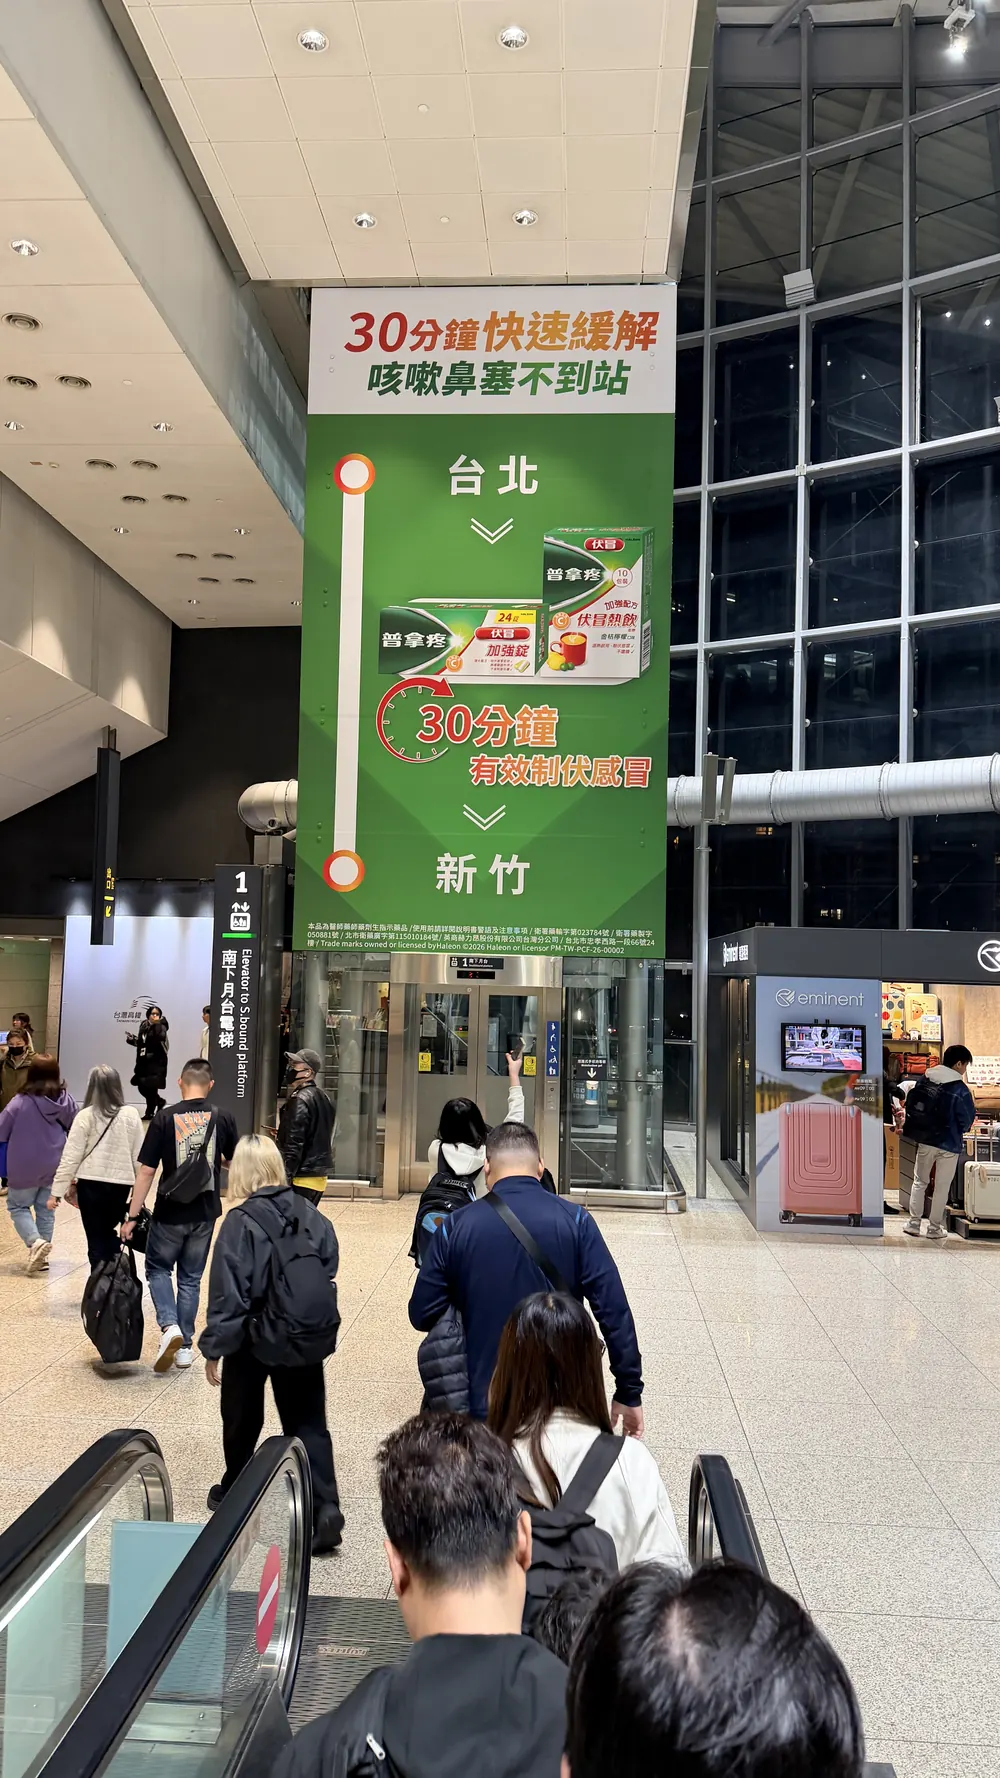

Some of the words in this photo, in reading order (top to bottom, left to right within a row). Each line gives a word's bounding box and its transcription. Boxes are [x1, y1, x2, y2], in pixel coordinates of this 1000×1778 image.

[344, 310, 660, 352] 30分鐘快速緩解
[367, 359, 632, 396] 咳嗽鼻塞不到站
[449, 454, 539, 496] 台北
[592, 539, 617, 549] 伏冒
[546, 567, 602, 582] 普拿疼
[617, 569, 628, 577] 10
[577, 613, 638, 628] 伏冒熱飲
[382, 632, 447, 651] 普拿疼
[491, 629, 515, 639] 伏冒
[487, 644, 530, 658] 加強錠
[416, 704, 559, 747] 30分鐘
[469, 754, 652, 787] 有效制伏感冒
[235, 871, 248, 893] 1
[436, 852, 530, 895] 新竹
[342, 940, 363, 948] marks
[398, 941, 426, 949] licensed
[486, 943, 512, 951] Haleon
[522, 944, 549, 952] licensor
[550, 945, 625, 954] PM-TW-PCF-26-00002
[240, 949, 252, 991] Elevator
[462, 958, 468, 967] 1
[218, 949, 238, 1048] 南下月台電梯
[240, 993, 250, 1003] to
[797, 991, 865, 1006] eminent
[238, 1006, 250, 1051] S.bound
[236, 1053, 249, 1098] platform
